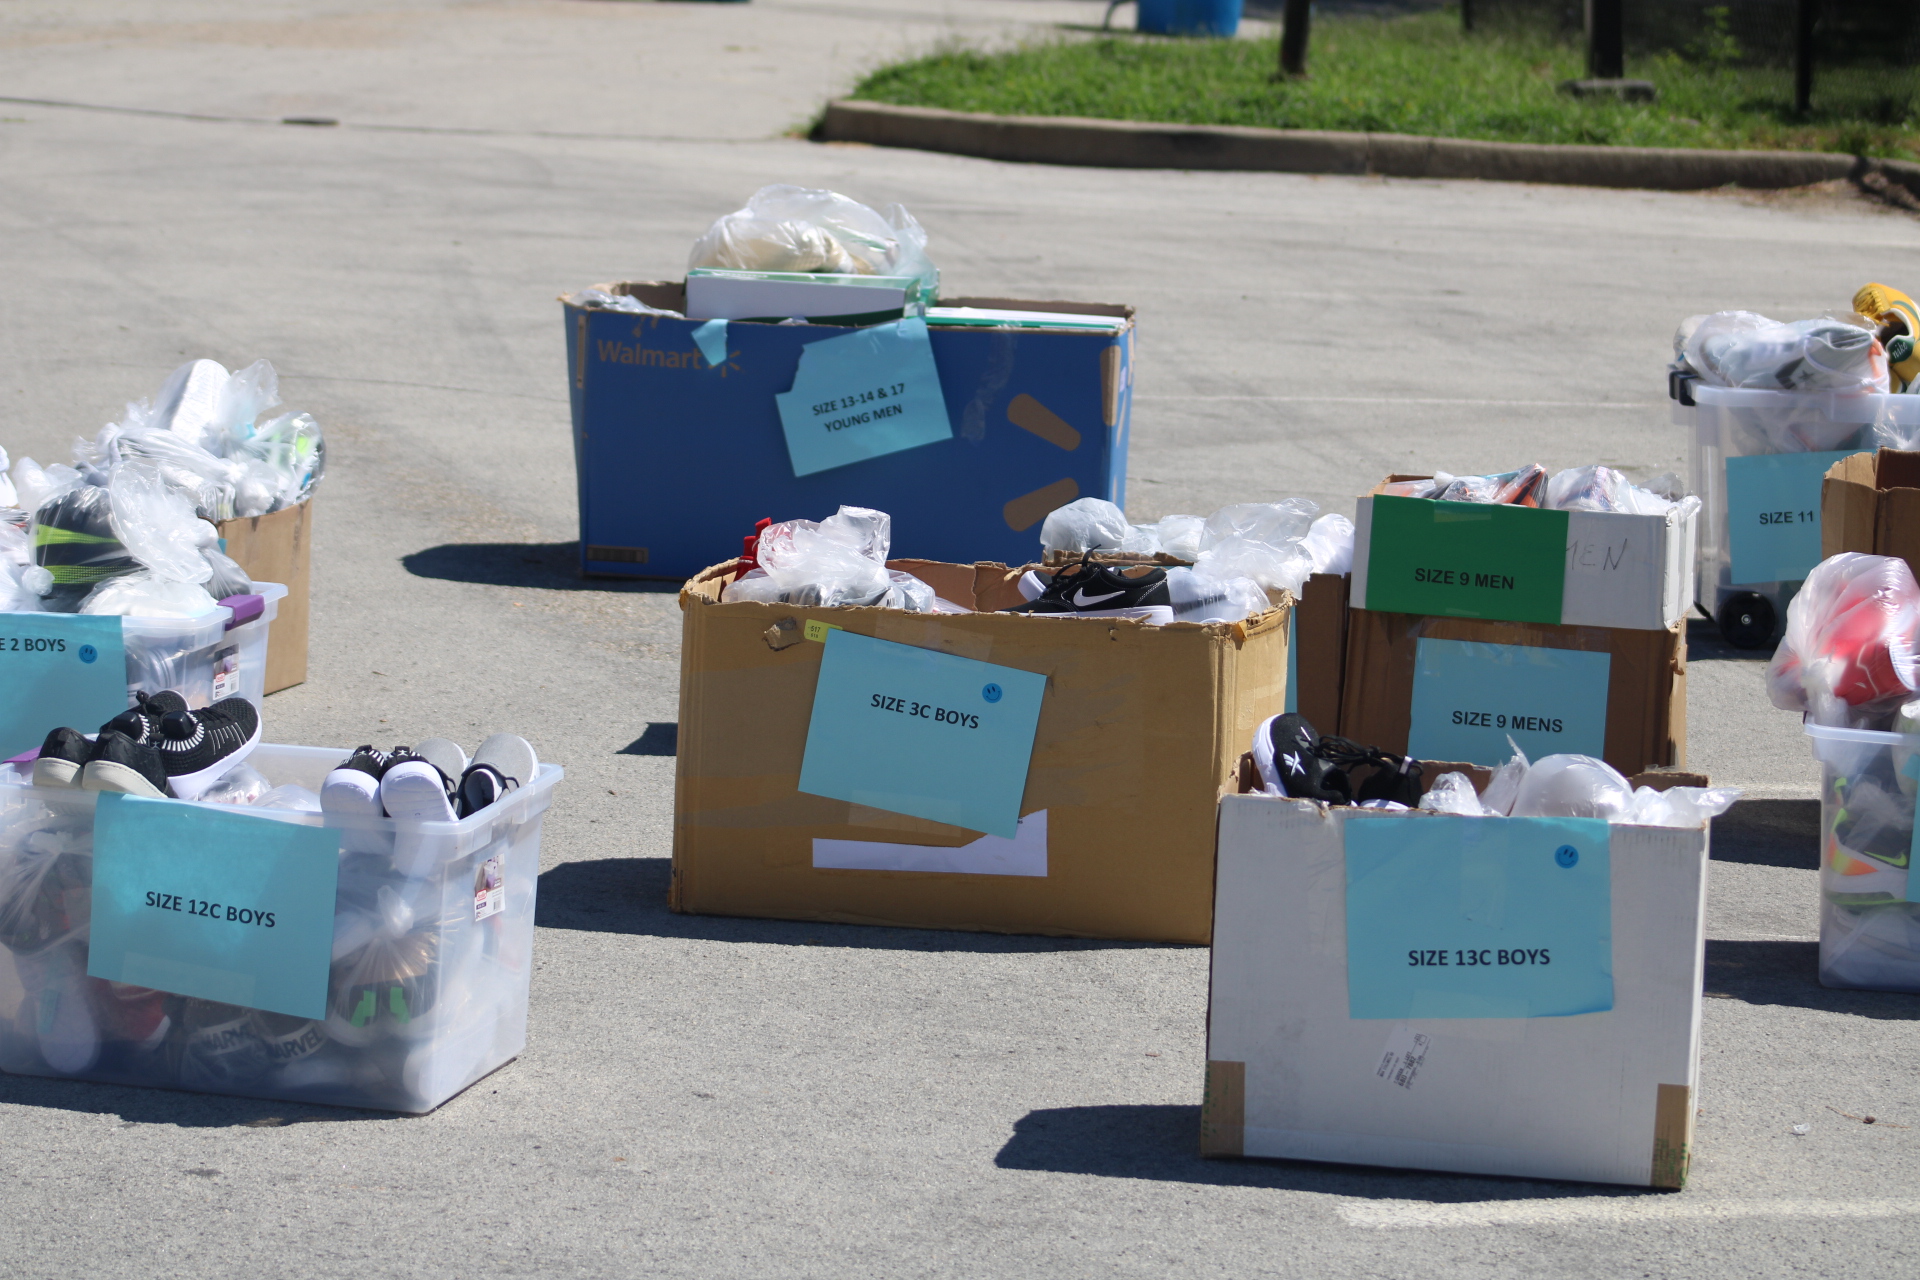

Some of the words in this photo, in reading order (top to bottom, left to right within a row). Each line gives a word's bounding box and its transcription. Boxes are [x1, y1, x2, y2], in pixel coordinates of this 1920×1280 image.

[597, 339, 701, 369] Walmart
[813, 401, 837, 415] SIZE
[840, 391, 875, 408] 13-14
[878, 388, 887, 398] &
[891, 383, 904, 395] 17
[824, 412, 870, 432] YOUNG
[873, 403, 902, 419] MEN
[1760, 512, 1793, 524] SIZE
[1798, 511, 1814, 523] 11
[1415, 568, 1454, 584] SIZE
[1460, 572, 1469, 585] 9
[1475, 574, 1513, 589] MEN
[11, 638, 19, 651] 2
[25, 639, 65, 652] BOYS
[871, 694, 905, 713] SIZE
[910, 702, 930, 718] 3C
[934, 708, 979, 729] BOYS
[1452, 711, 1491, 727] SIZE
[1497, 715, 1506, 728] 9
[1512, 716, 1562, 732] MENS
[145, 892, 183, 912] SIZE
[189, 900, 221, 918] 12C
[227, 906, 275, 927] BOYS
[1409, 950, 1448, 966] SIZE
[1456, 950, 1491, 965] 13C
[1498, 949, 1550, 965] BOYS
[203, 1024, 256, 1050] ARV
